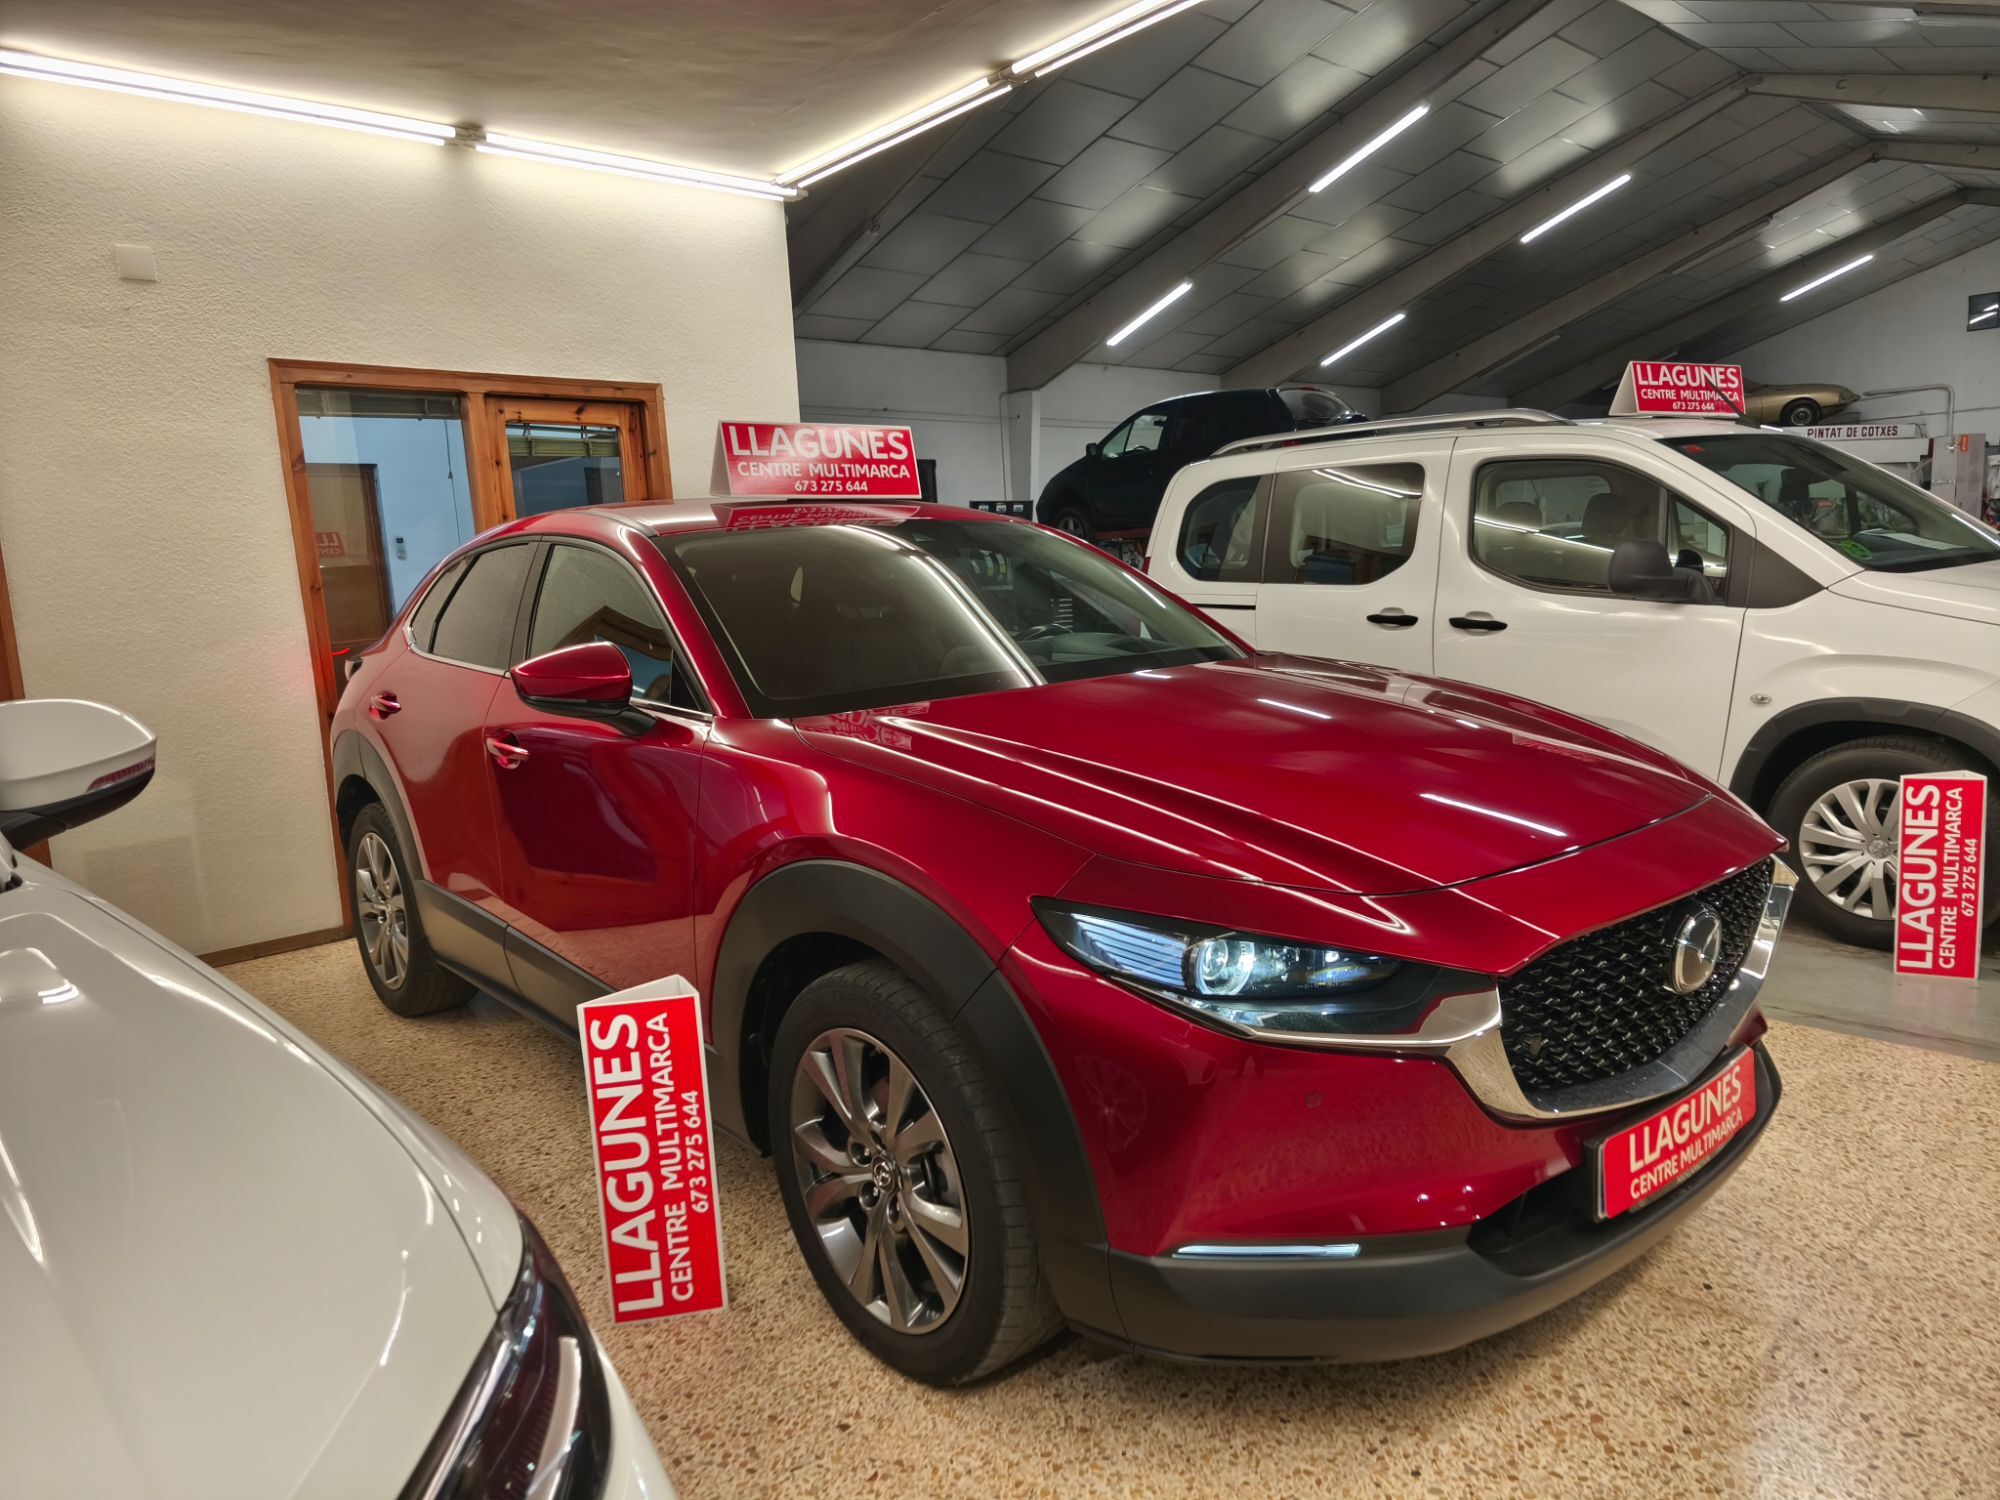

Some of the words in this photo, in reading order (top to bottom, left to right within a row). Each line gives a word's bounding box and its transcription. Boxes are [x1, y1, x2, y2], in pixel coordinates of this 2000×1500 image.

[1636, 364, 1739, 388] LLAGUNES
[1641, 388, 1676, 400] CENTRE
[1672, 401, 1686, 410] 673
[1687, 402, 1700, 410] 275
[1701, 402, 1714, 410] 644
[729, 426, 908, 460] LLAGUNES
[1807, 428, 1843, 438] PINTAT
[1846, 427, 1857, 438] DE
[1861, 425, 1898, 437] COTXES
[737, 461, 801, 477] CENTRE
[809, 463, 910, 478] MULTIMARCA
[795, 480, 817, 492] 673
[821, 481, 843, 492] 275
[846, 481, 868, 492] 644
[1941, 787, 1963, 899] MULTIMARCA
[1964, 838, 1978, 864] 644
[1900, 784, 1941, 969] LLAGUNES
[1962, 865, 1976, 891] 275
[1961, 892, 1975, 917] 673
[1939, 905, 1957, 969] CENTRE
[645, 1012, 683, 1190] MULTIMARCA
[681, 1090, 701, 1129] 644
[1629, 1065, 1741, 1173] LLAGUNES
[590, 1014, 663, 1313] LLAGUNES
[685, 1133, 705, 1170] 275
[1630, 1154, 1678, 1199] CENTRE
[1680, 1107, 1742, 1169] MULTIMARCA
[690, 1173, 709, 1213] 673
[664, 1201, 694, 1302] CENTRE
